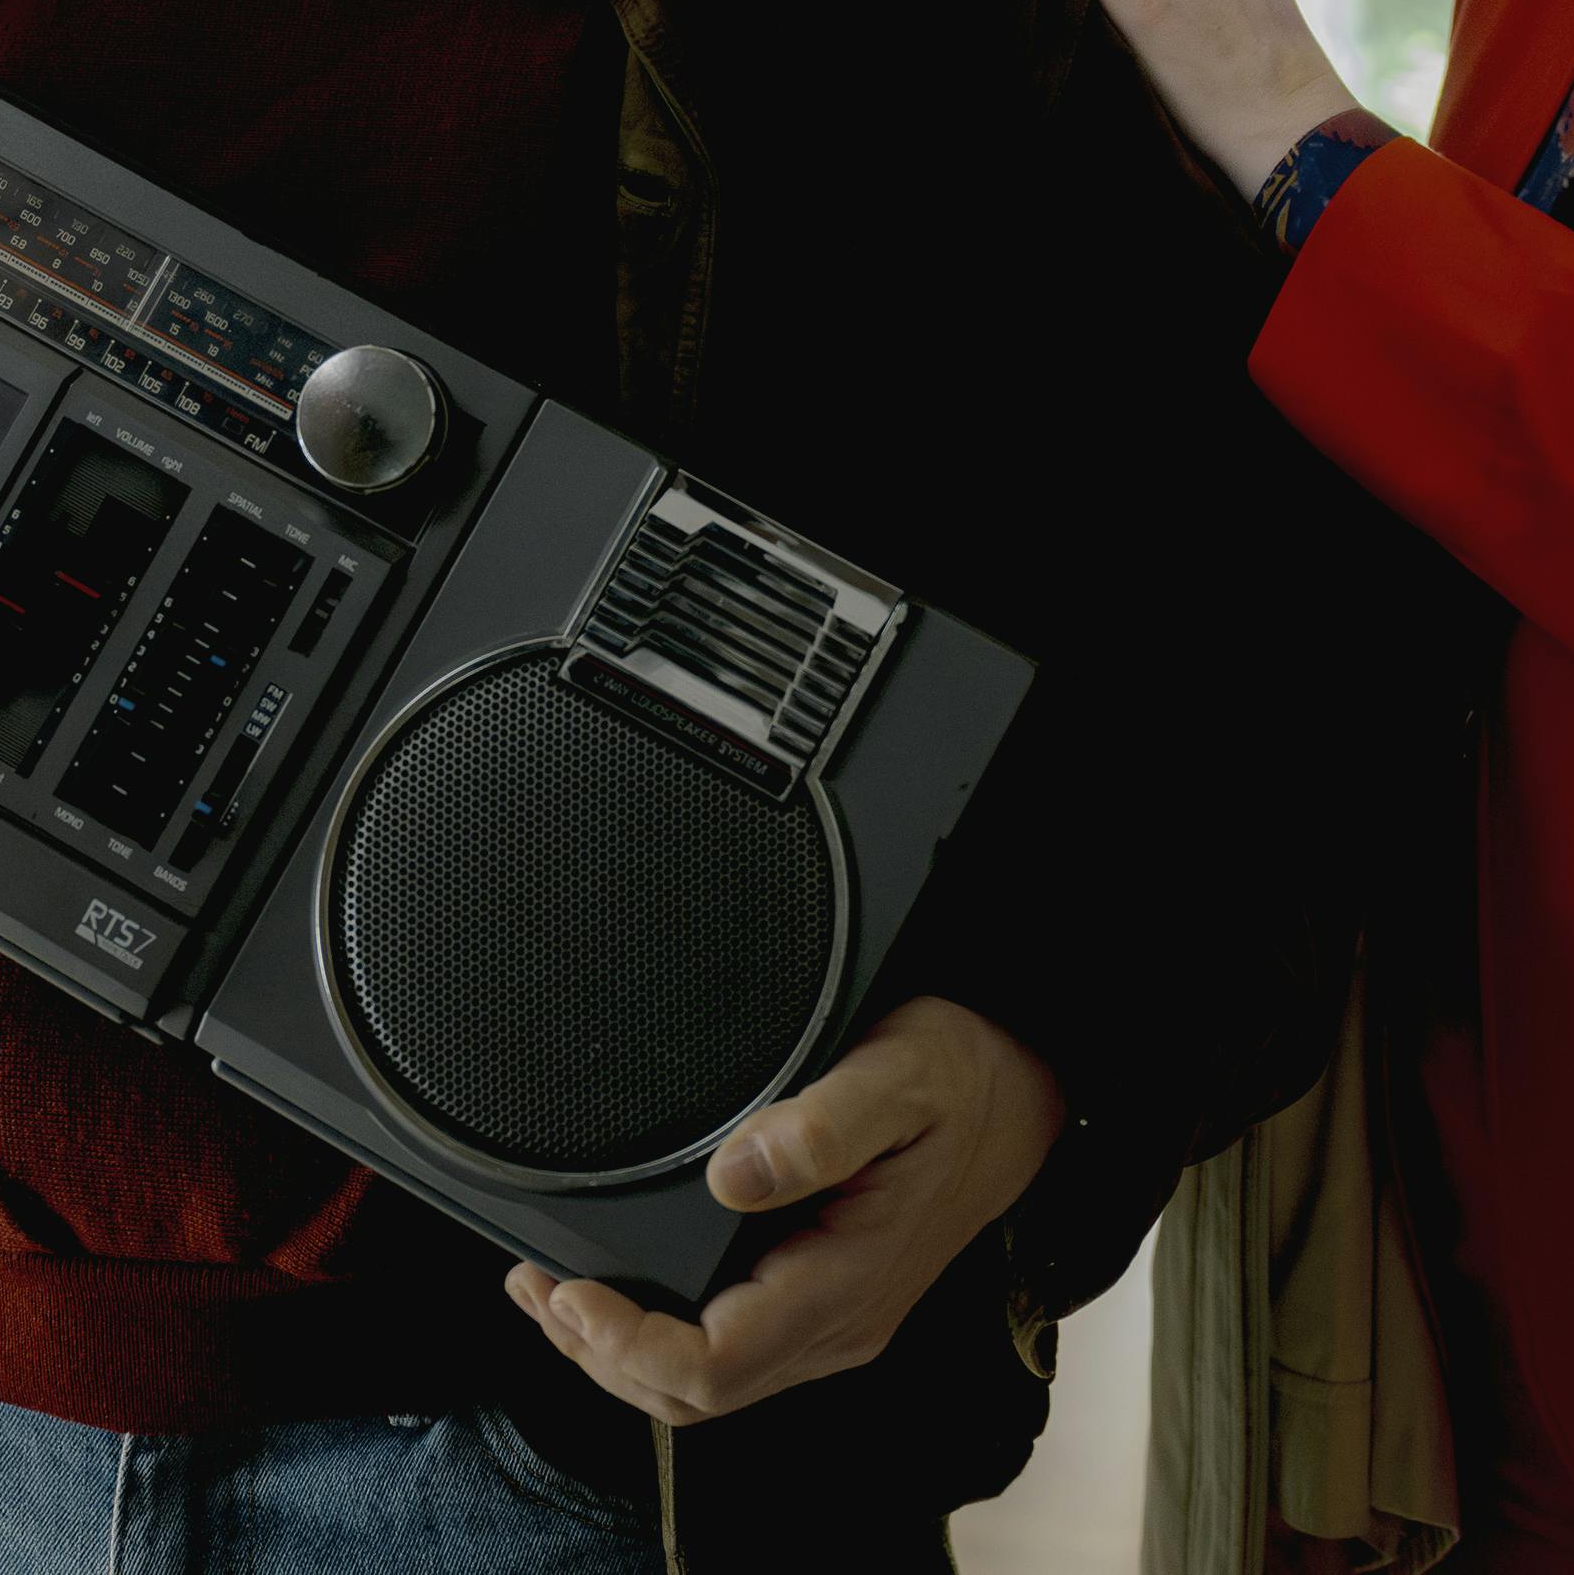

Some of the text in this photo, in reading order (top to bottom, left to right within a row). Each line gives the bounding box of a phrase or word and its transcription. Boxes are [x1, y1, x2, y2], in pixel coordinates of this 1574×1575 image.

[115, 244, 136, 261] 220
[19, 209, 42, 227] 600
[56, 228, 76, 246] 700
[168, 290, 191, 310] 1300
[204, 311, 229, 331] 1600
[52, 258, 62, 269] 8
[91, 279, 104, 293] 10
[29, 312, 49, 330] 96
[67, 333, 86, 351] 99
[104, 353, 126, 374] 102
[141, 374, 163, 394] 105
[178, 395, 201, 415] 108
[244, 433, 267, 453] FM
[86, 411, 183, 473] left VOLUME right
[11, 509, 21, 520] 6
[227, 492, 310, 545] SPATIAL TONE
[136, 645, 146, 656] 3
[83, 656, 90, 666] 1
[127, 661, 137, 673] 2
[72, 672, 82, 684] 0
[120, 677, 128, 688] 1
[109, 693, 119, 705] 0
[267, 685, 284, 700] FM
[260, 697, 278, 713] SW
[251, 709, 271, 726] MW
[245, 723, 263, 738] LW
[718, 741, 768, 775] SYSTEM
[54, 807, 84, 830] MONO
[108, 838, 133, 859] TONE
[153, 866, 188, 892] BANDS
[82, 899, 156, 953] RTS7
